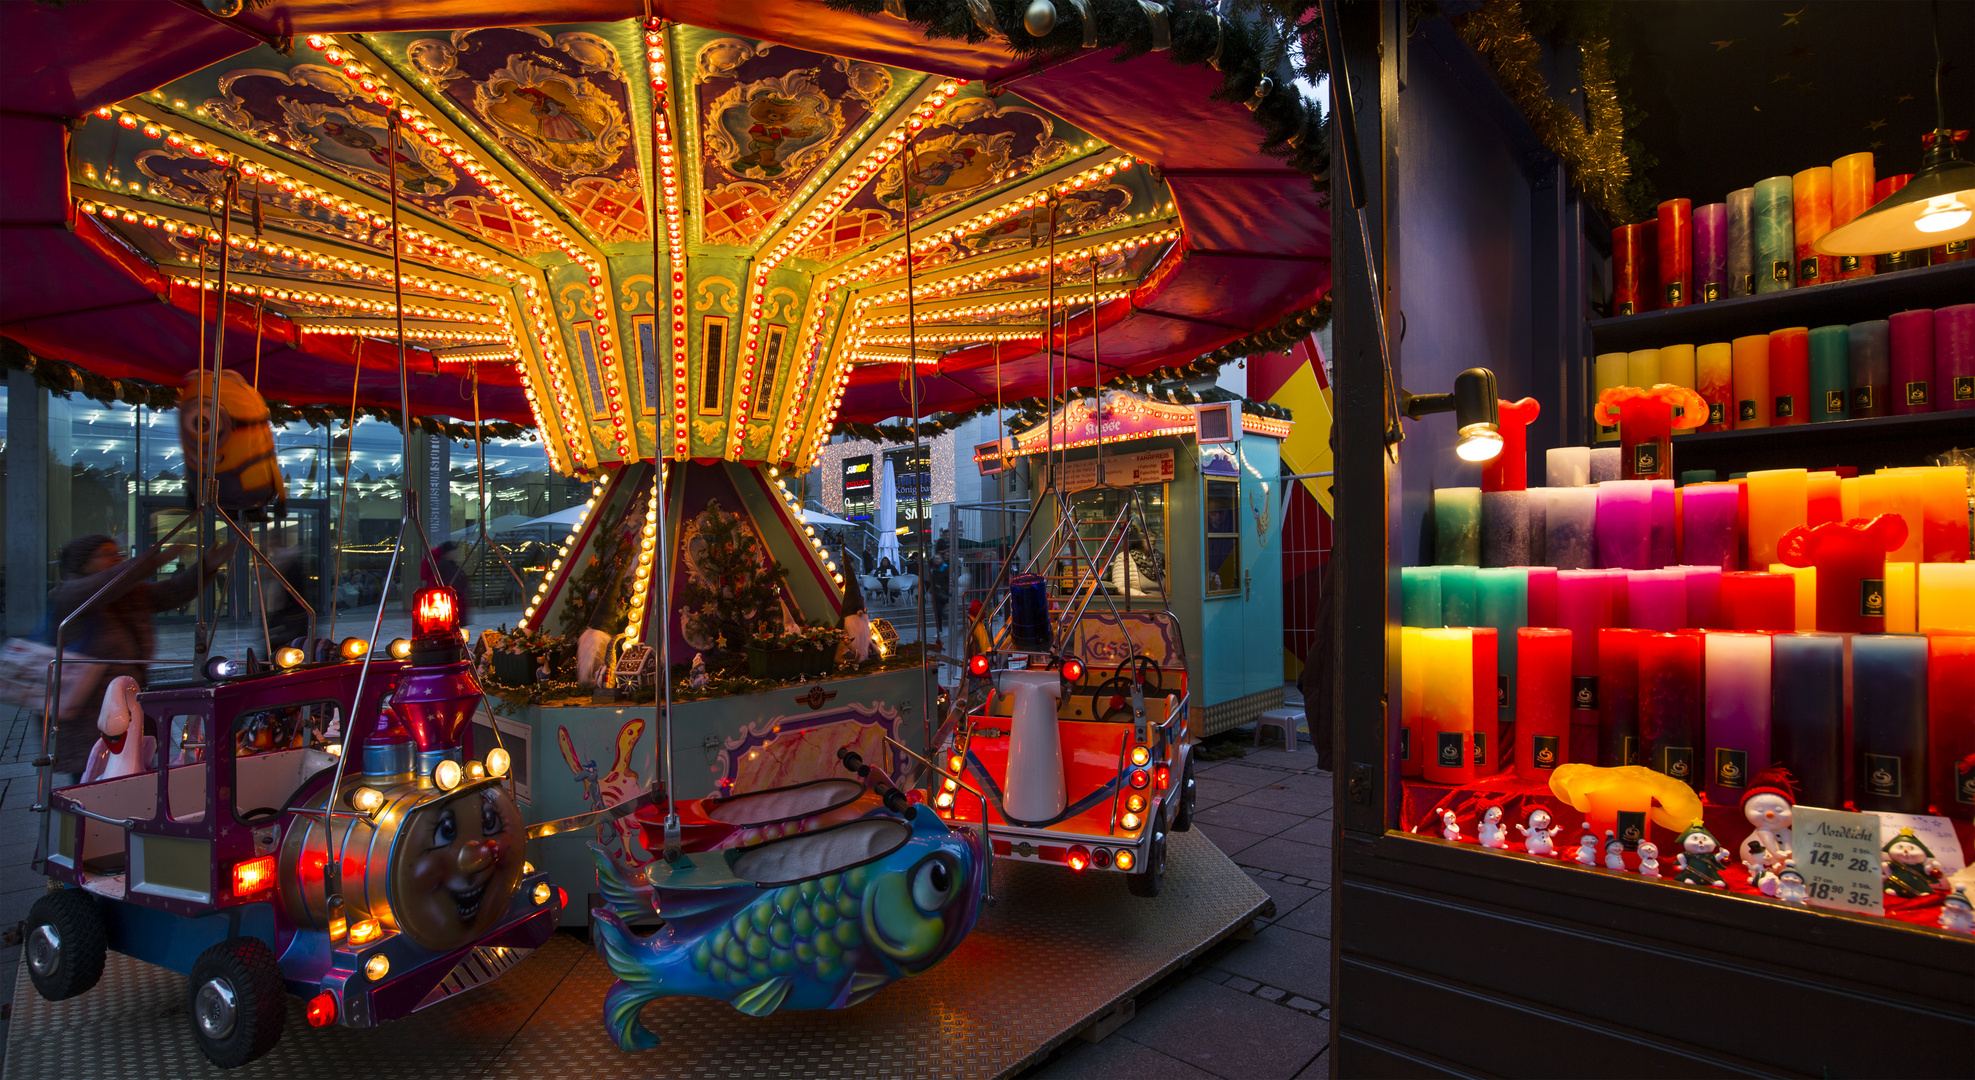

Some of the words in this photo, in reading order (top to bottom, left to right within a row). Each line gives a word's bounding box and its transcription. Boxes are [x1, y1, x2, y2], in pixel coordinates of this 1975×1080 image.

[1137, 453, 1169, 462] FAHRPREIS
[846, 462, 870, 475] SUBWAY
[895, 485, 931, 495] Königba
[905, 506, 932, 520] SAU
[1081, 634, 1142, 662] Kasse
[1808, 822, 1873, 841] Nordlicht
